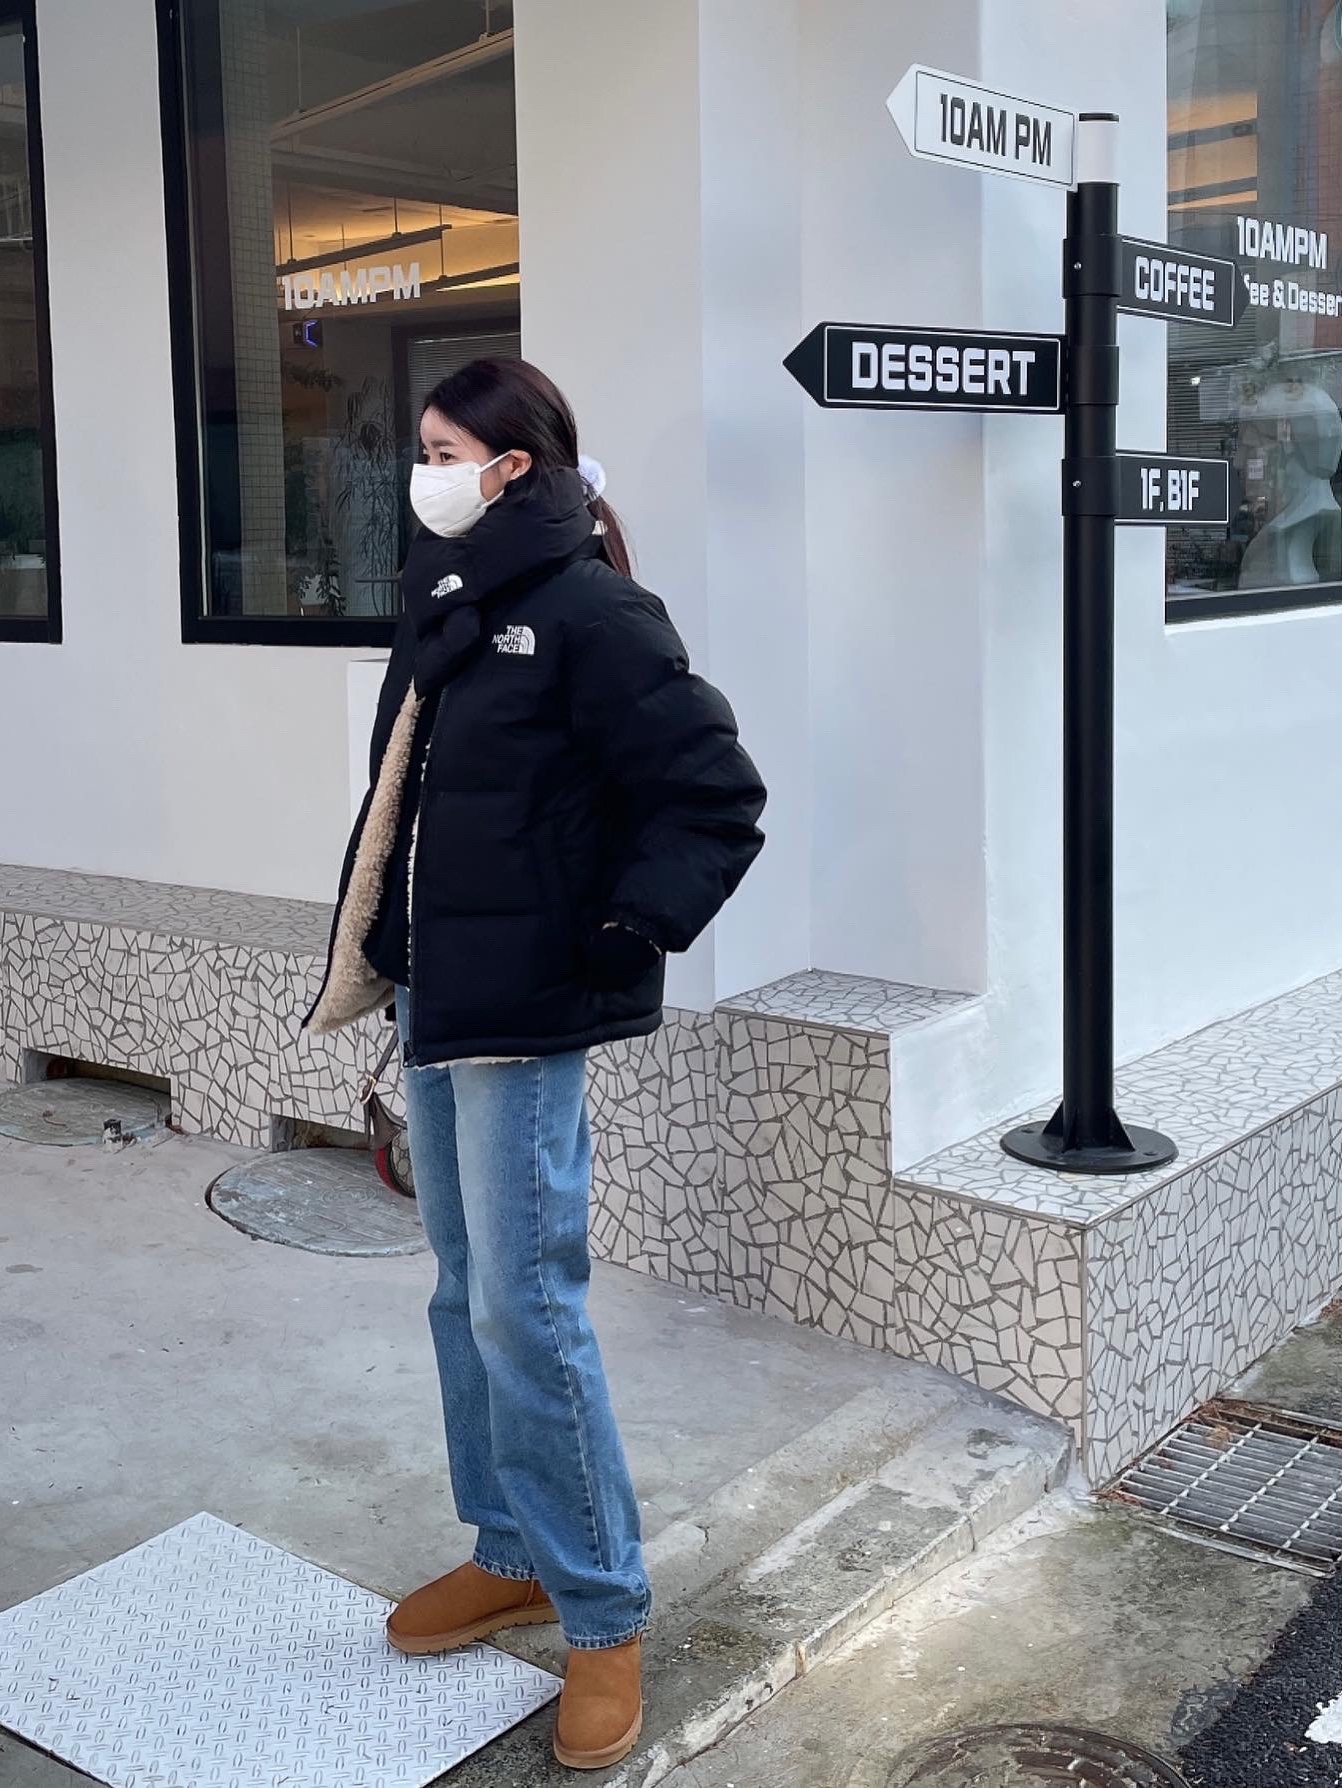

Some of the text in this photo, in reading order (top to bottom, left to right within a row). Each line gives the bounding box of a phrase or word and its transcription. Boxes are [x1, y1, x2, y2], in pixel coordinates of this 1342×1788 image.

[940, 93, 1052, 167] 10AM PM
[1237, 215, 1328, 270] 10AMPM
[282, 261, 421, 311] 10AMPM
[1135, 255, 1216, 311] COFFEE
[1272, 279, 1286, 309] &
[852, 341, 1036, 396] DESSERT
[492, 634, 521, 644] NORTH
[497, 643, 520, 654] FACE
[506, 625, 523, 635] THE
